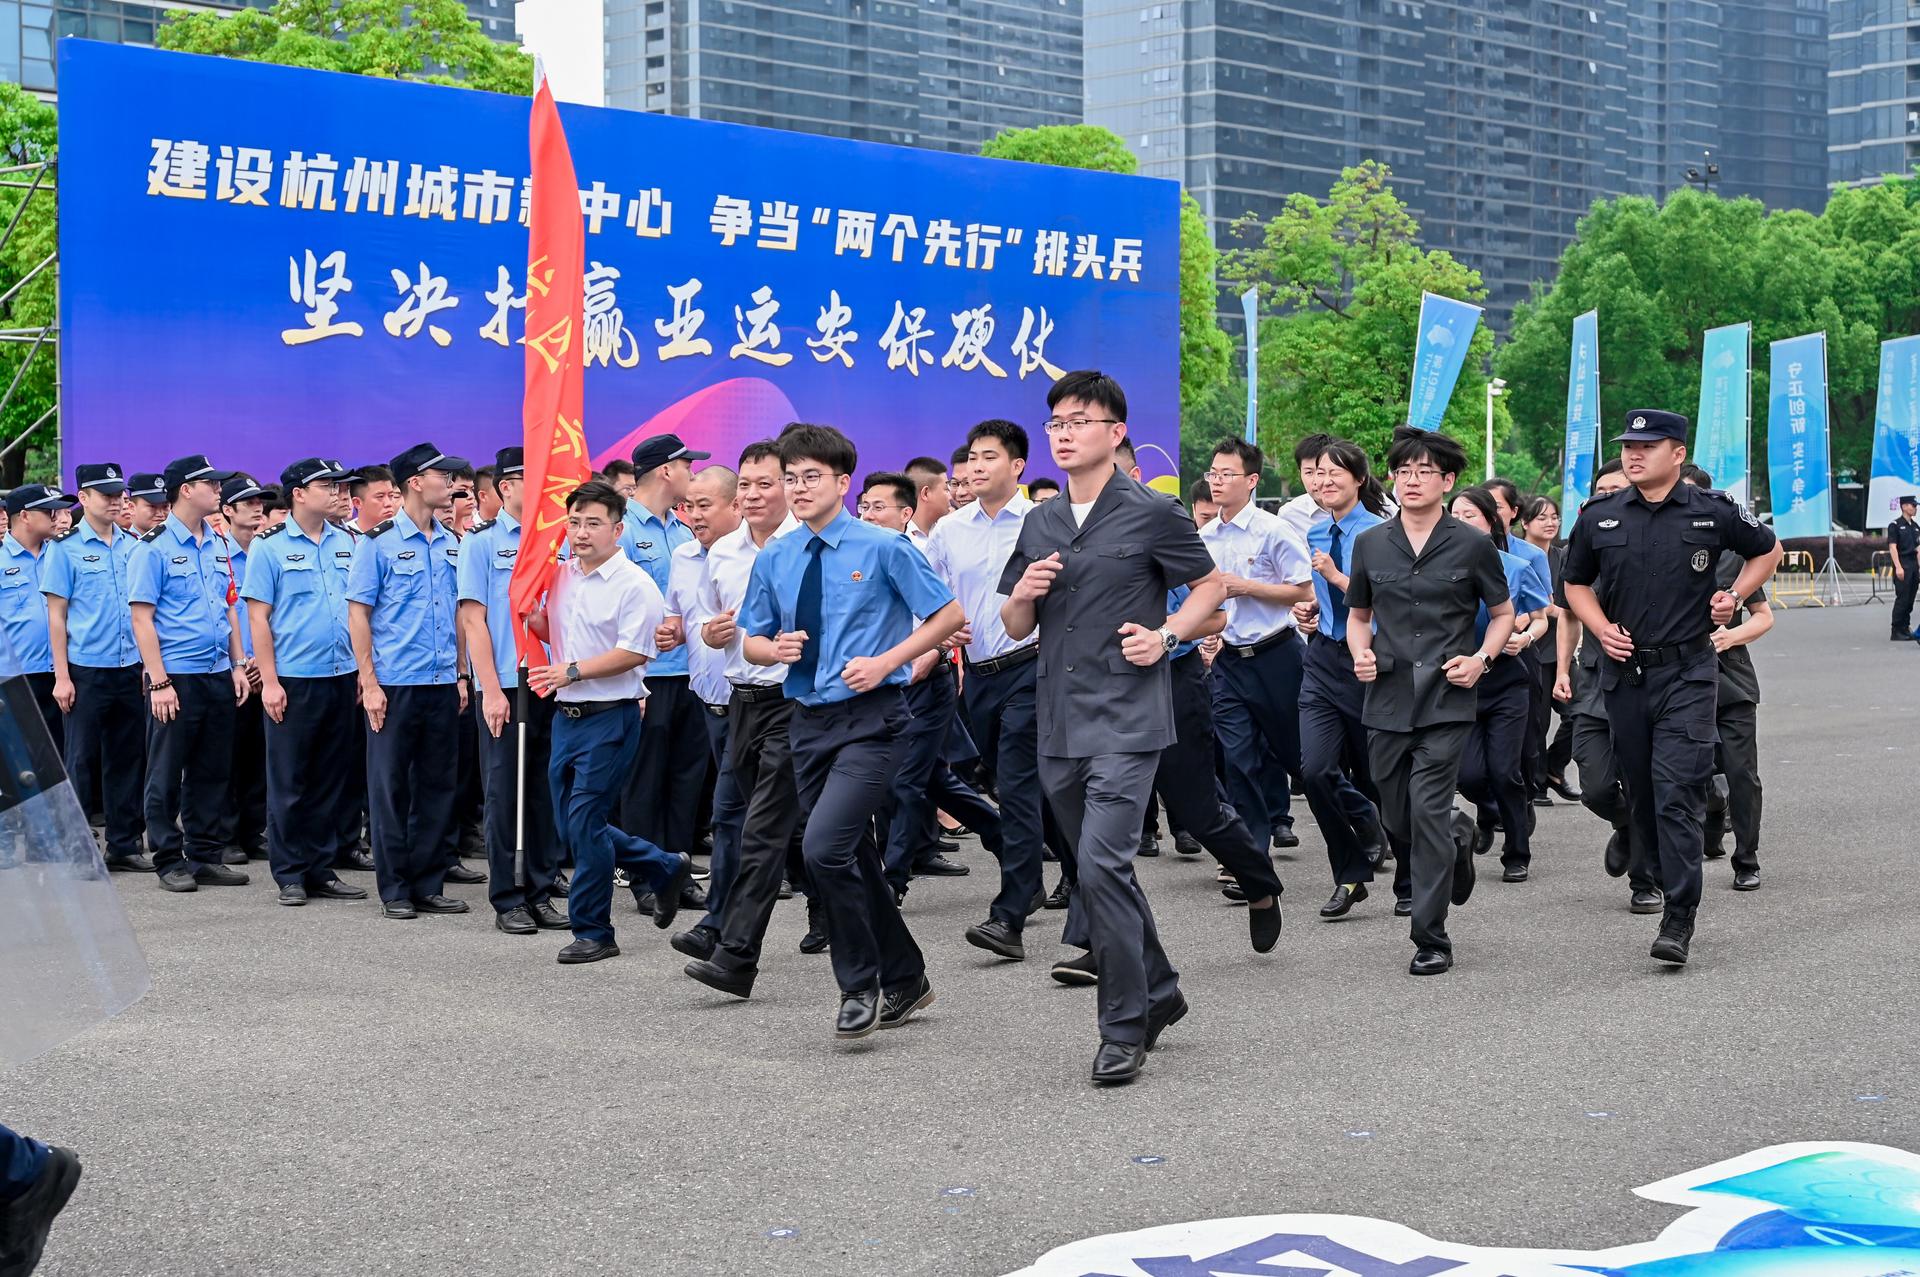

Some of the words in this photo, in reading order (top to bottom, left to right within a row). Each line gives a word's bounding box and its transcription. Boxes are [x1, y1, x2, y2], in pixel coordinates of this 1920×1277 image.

[146, 137, 672, 239] 建设杭州城市中心
